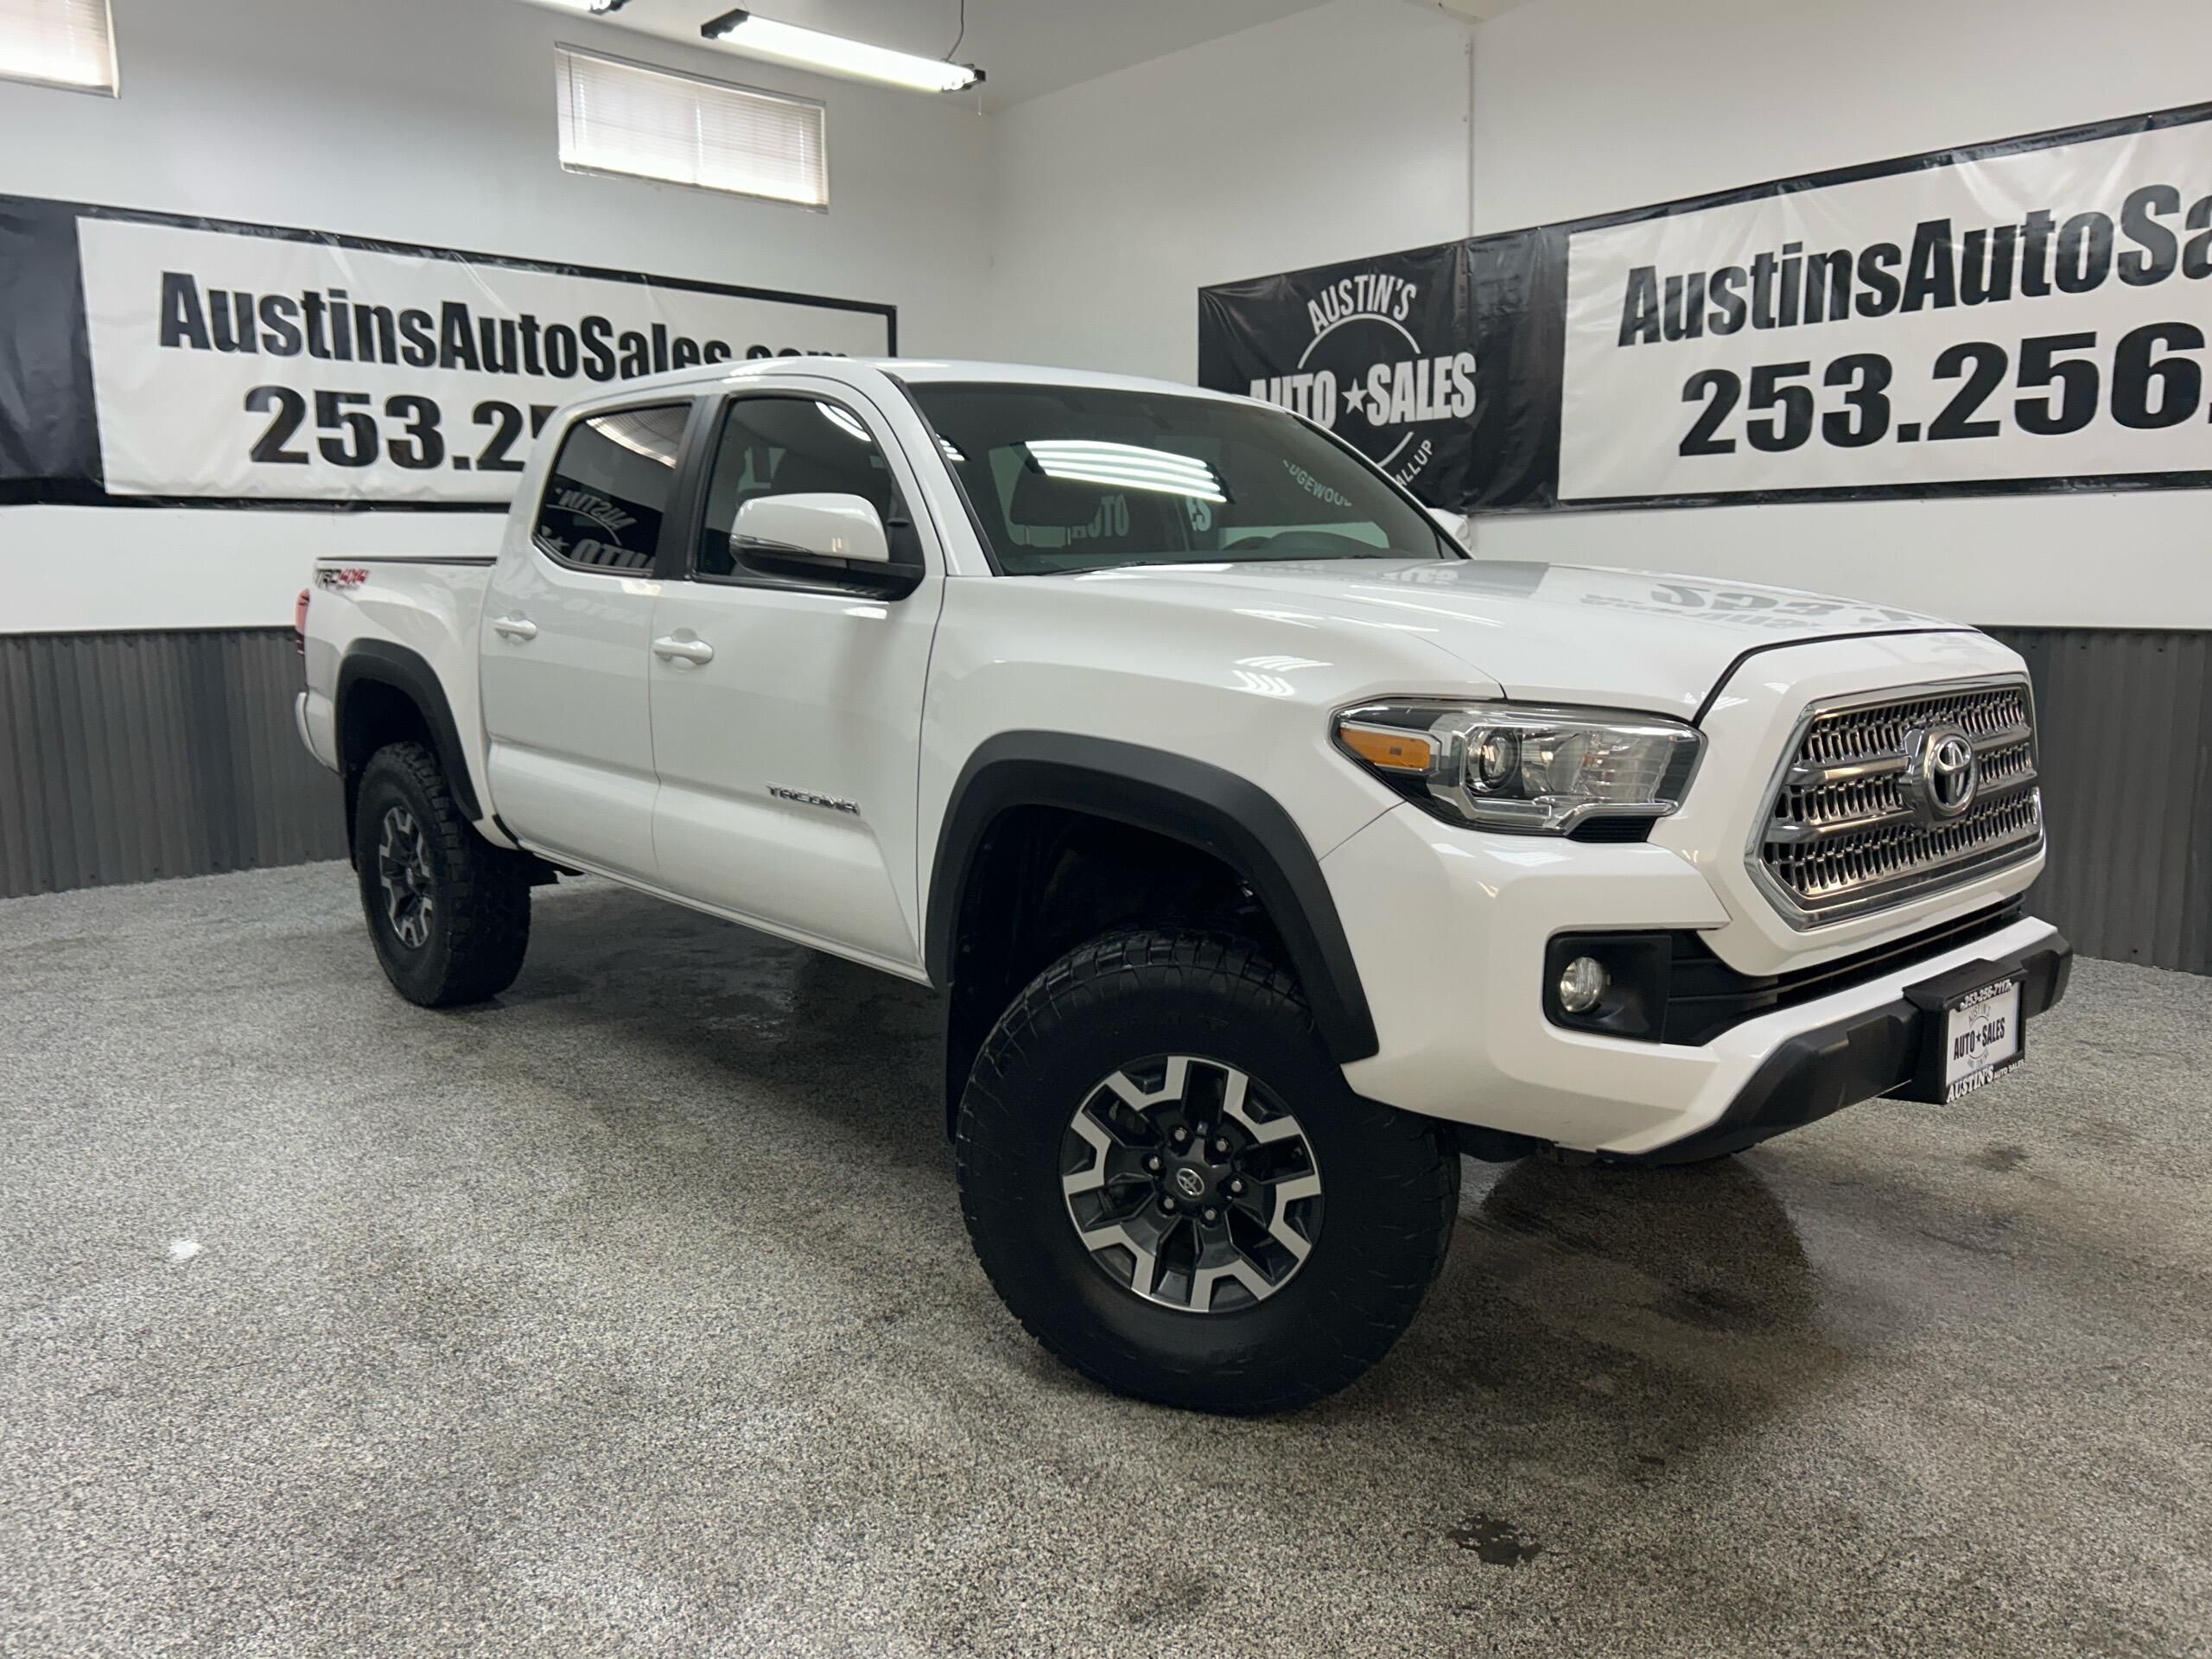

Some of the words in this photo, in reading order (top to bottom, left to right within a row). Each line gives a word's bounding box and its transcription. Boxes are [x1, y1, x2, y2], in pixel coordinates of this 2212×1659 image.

[159, 271, 849, 383] AustinsAutoSale
[1306, 274, 1417, 334] AUSTIN'S
[1366, 352, 1477, 427] SALES
[1679, 322, 2212, 456] 253.256
[245, 385, 557, 472] 253.2
[766, 781, 861, 816] TACOMA
[1954, 1030, 1975, 1060] AUTO
[1982, 1017, 2005, 1047] SALES
[1947, 1065, 1994, 1103] AUSTIN'S
